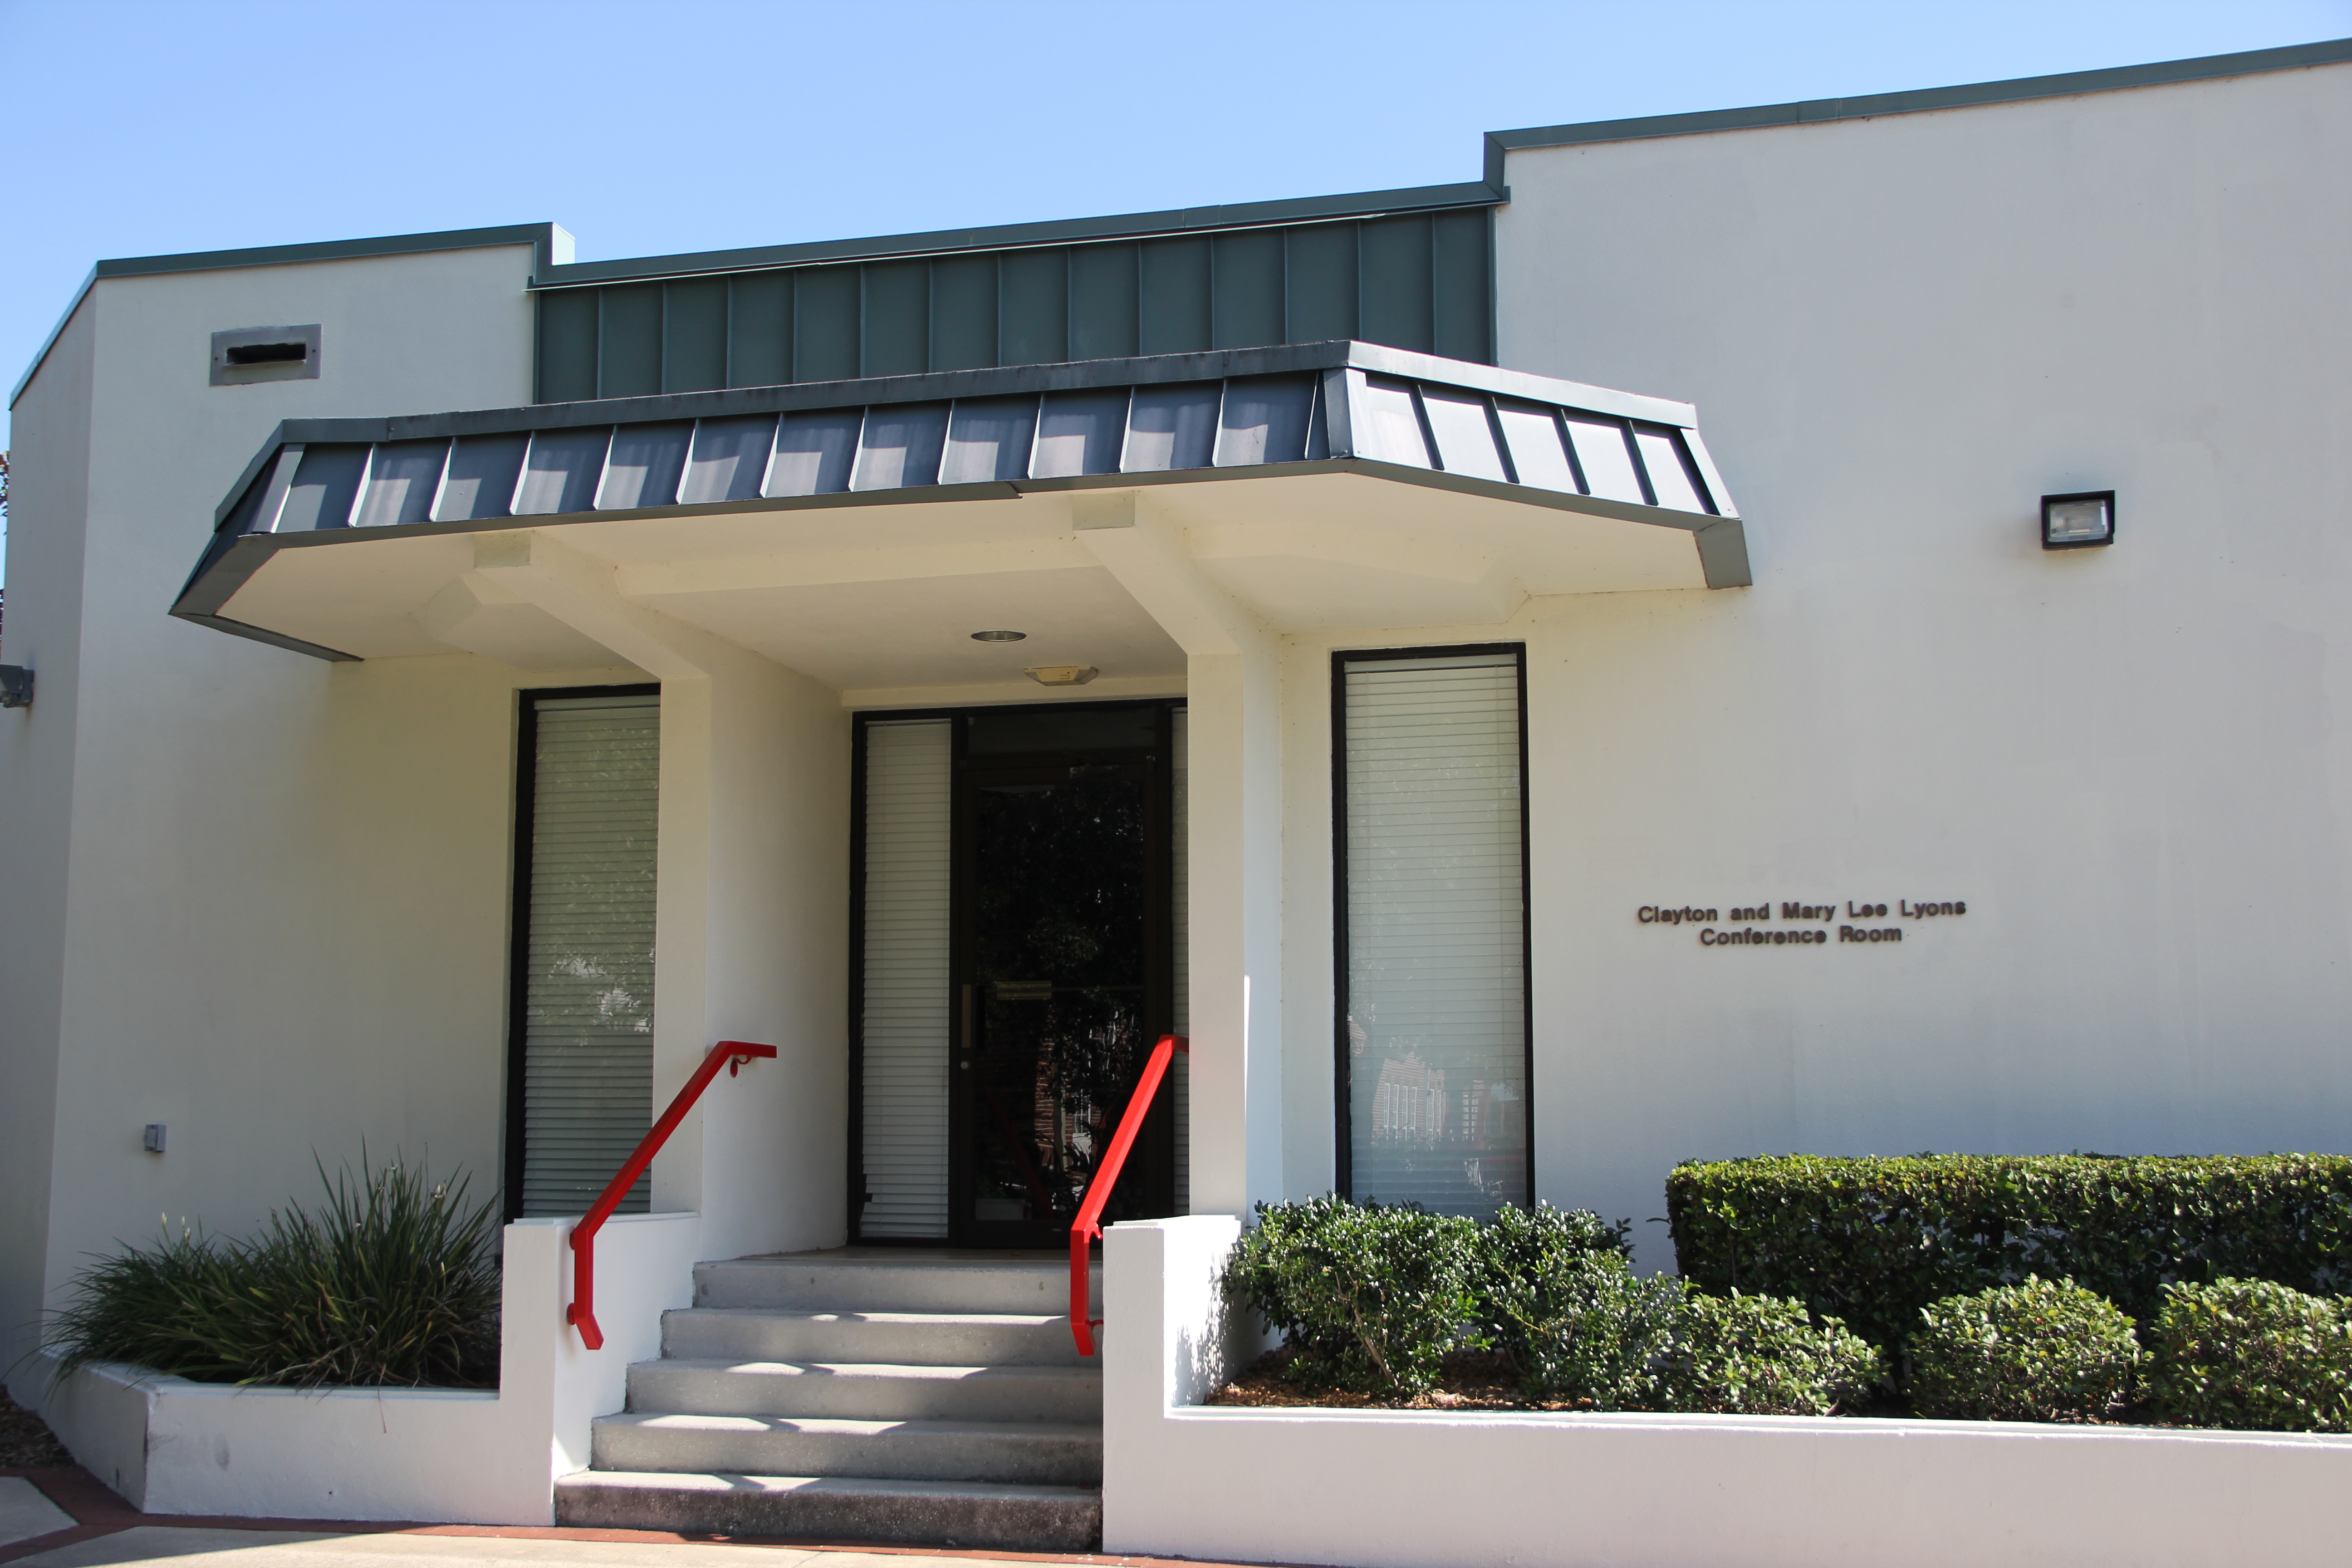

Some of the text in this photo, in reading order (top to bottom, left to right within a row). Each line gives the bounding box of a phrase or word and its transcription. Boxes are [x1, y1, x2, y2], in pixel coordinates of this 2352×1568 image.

[1637, 899, 1966, 926] Clayton and Mary Lee Lyons
[1700, 925, 1902, 947] Conference Room
